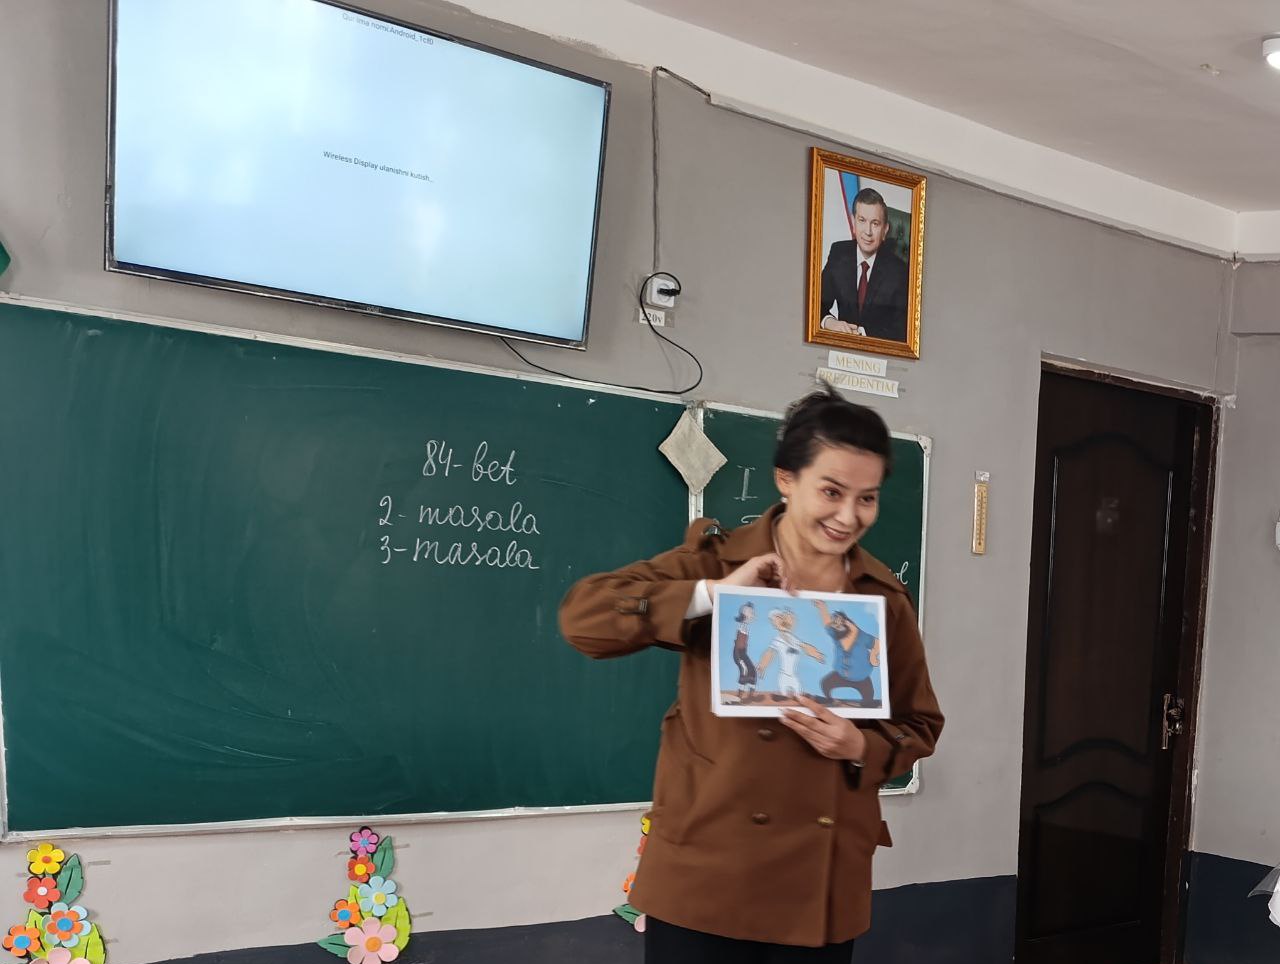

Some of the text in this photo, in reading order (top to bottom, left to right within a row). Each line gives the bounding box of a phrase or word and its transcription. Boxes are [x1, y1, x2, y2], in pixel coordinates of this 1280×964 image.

[323, 151, 353, 164] Wireless
[354, 157, 379, 171] Display
[836, 355, 881, 373] MENING
[819, 371, 896, 393] PREZIDENTIM
[472, 441, 517, 485] bet
[418, 501, 541, 534] masala
[413, 537, 540, 569] masala
